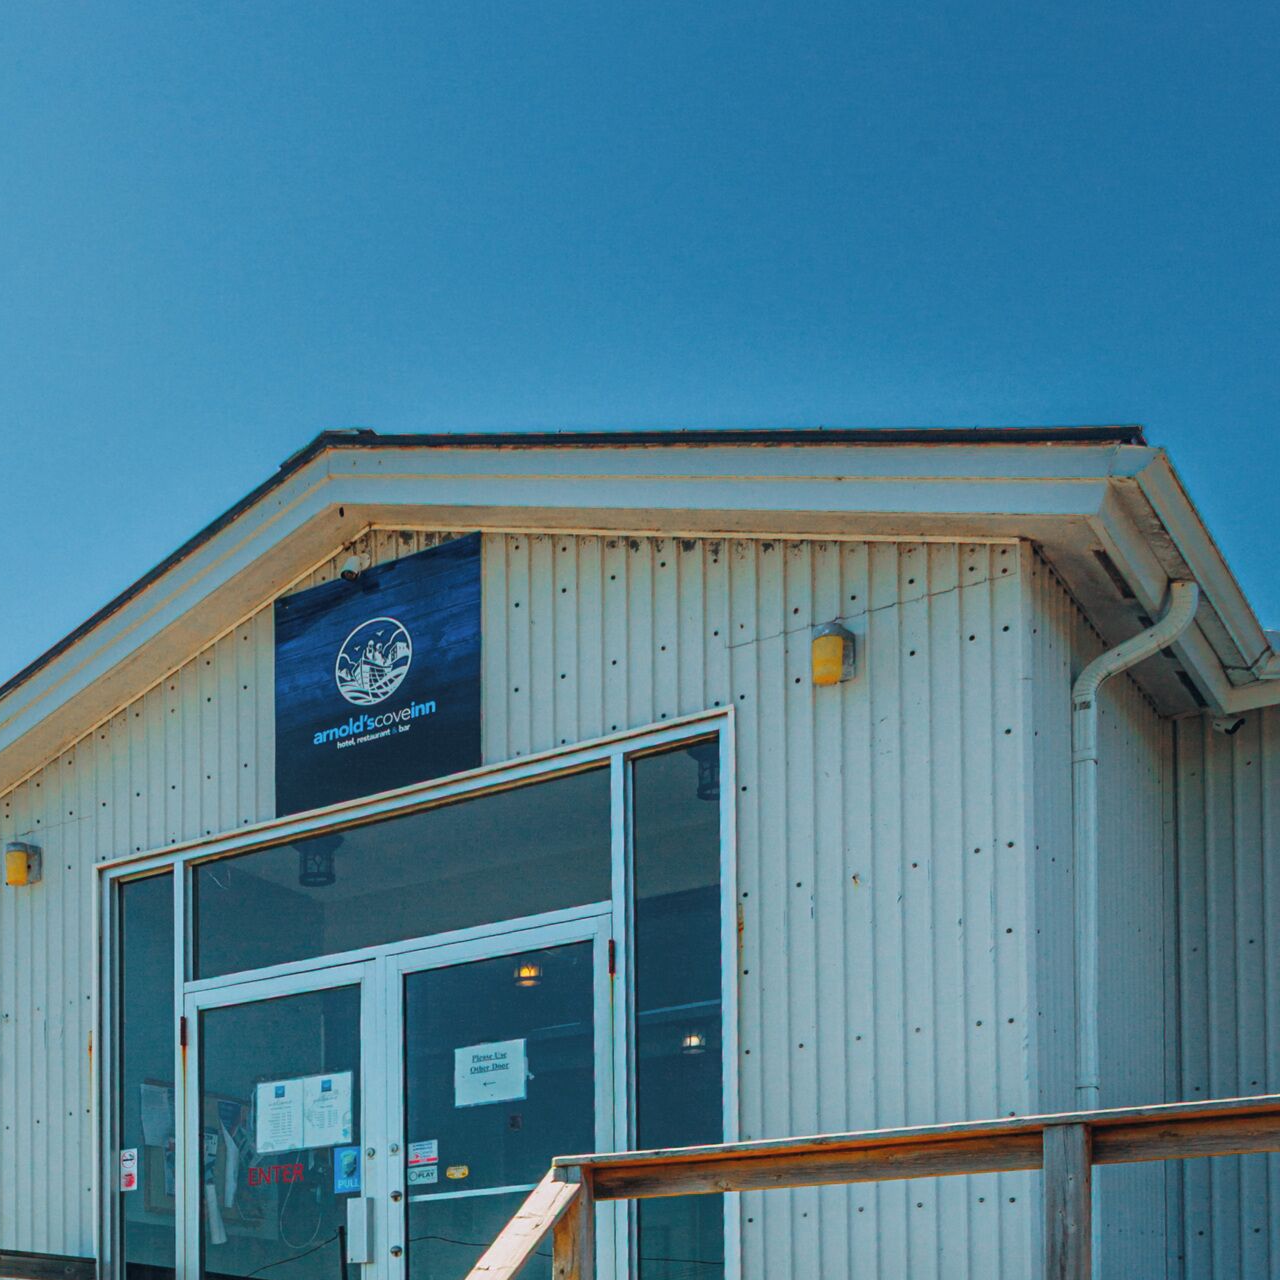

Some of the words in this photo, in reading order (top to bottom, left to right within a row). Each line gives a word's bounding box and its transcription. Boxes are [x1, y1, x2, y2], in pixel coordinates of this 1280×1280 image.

[336, 738, 356, 750] hotel,
[357, 728, 391, 744] restaurant
[398, 723, 411, 733] bar
[472, 1053, 493, 1064] Please
[494, 1051, 508, 1060] Use
[470, 1065, 490, 1075] Other
[492, 1062, 510, 1071] Door
[248, 1163, 305, 1187] ENTER
[337, 1179, 360, 1189] PULL
